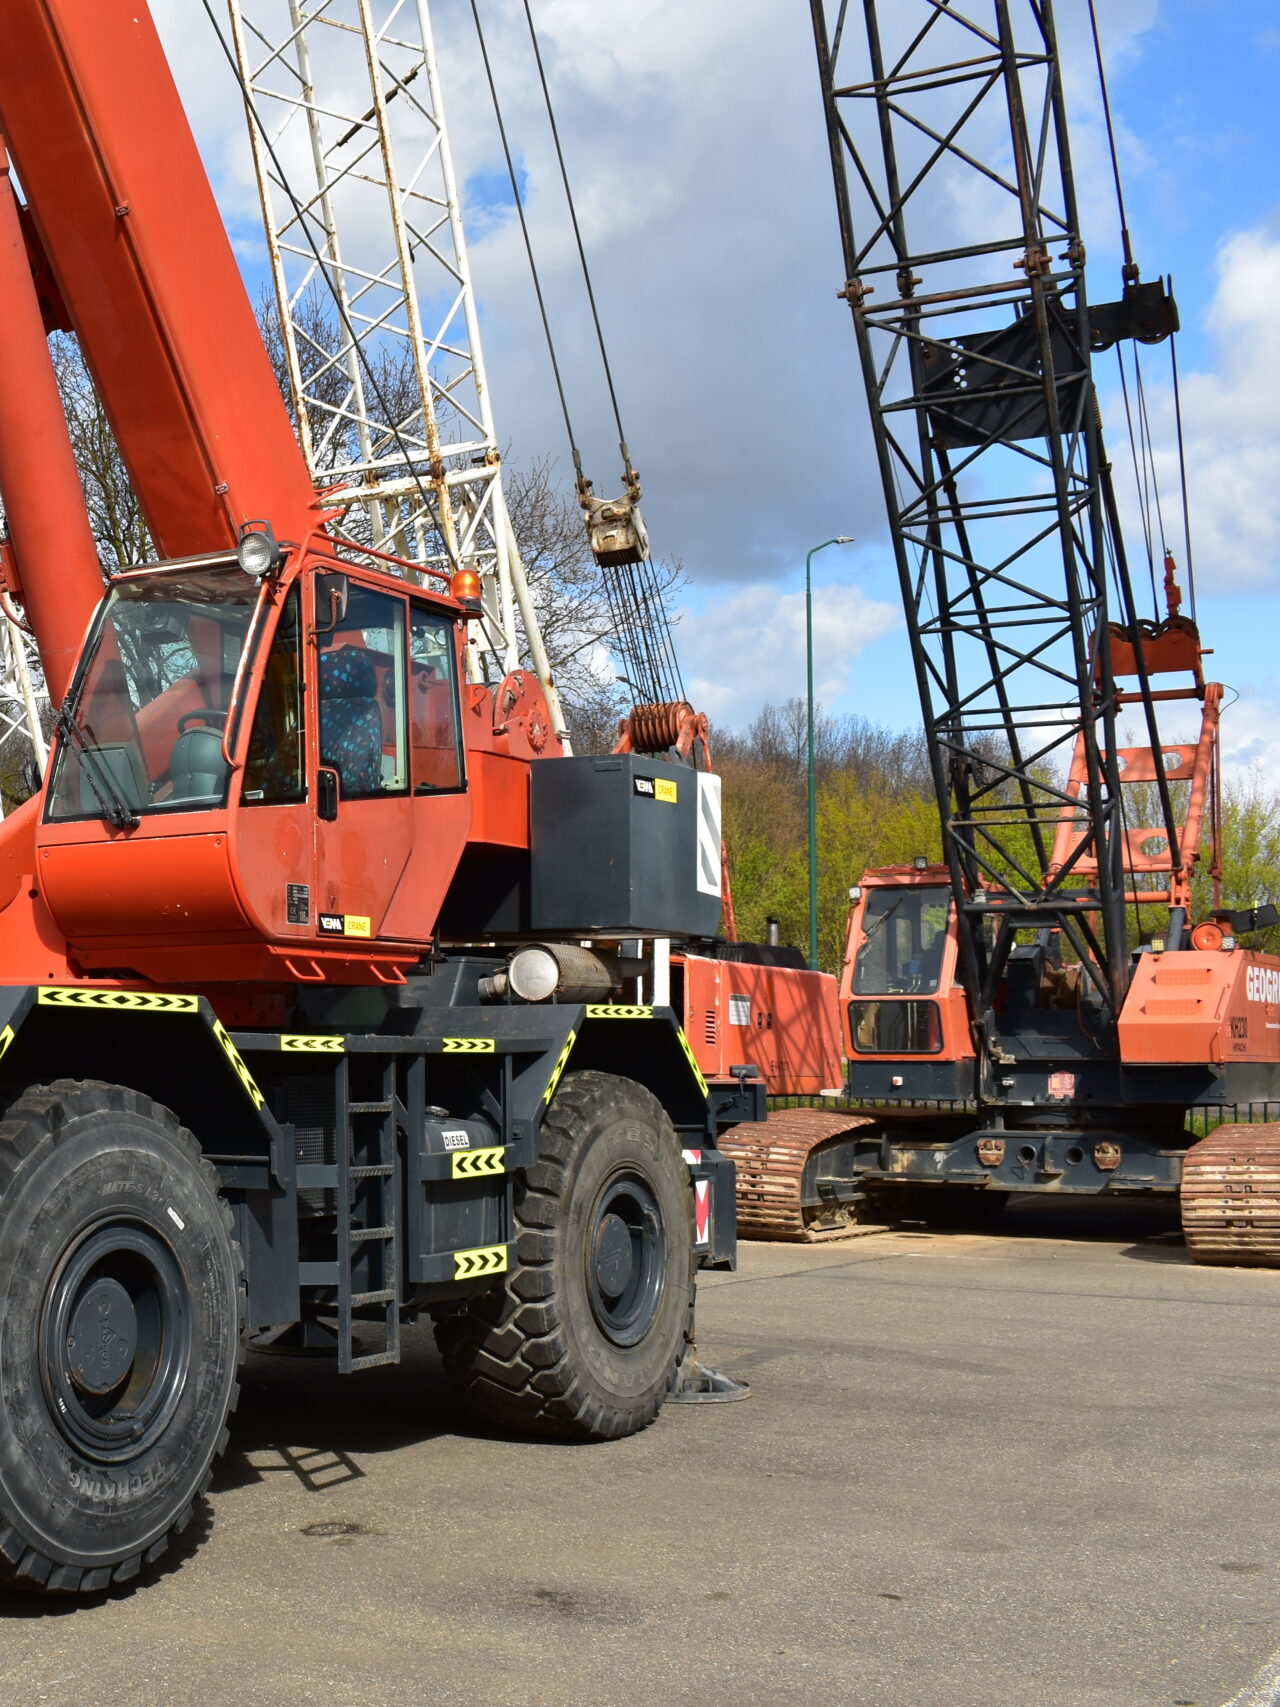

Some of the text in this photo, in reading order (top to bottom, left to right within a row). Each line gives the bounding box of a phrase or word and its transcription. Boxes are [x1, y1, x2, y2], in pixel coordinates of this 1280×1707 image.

[347, 920, 367, 932] CRANE
[1246, 965, 1280, 1004] GEOGR
[444, 1135, 469, 1147] DIESEL
[69, 1460, 166, 1502] TECHKING
